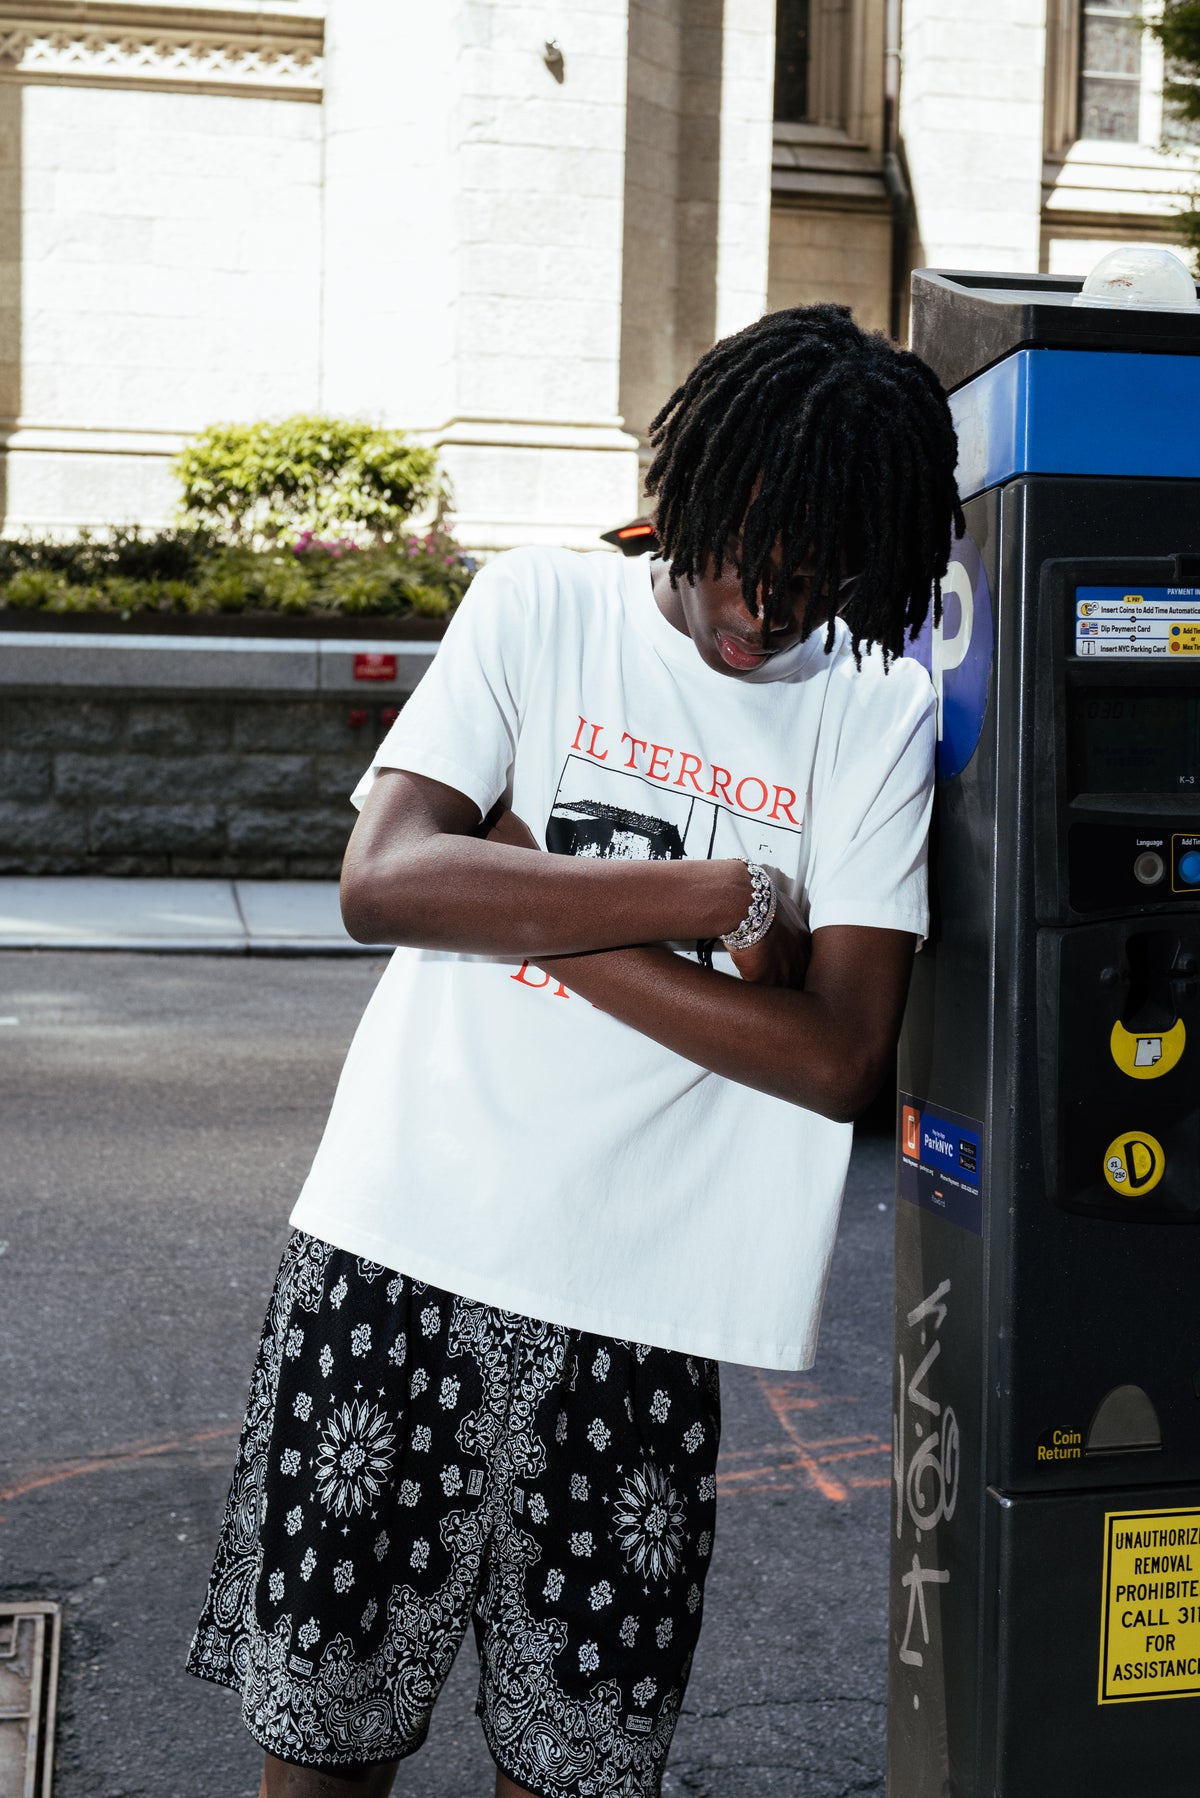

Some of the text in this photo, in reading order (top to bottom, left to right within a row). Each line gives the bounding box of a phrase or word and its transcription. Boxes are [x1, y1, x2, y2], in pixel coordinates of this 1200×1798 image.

[1167, 588, 1194, 596] PAYMENT
[1101, 606, 1118, 614] Insert
[1119, 606, 1135, 614] Coins
[1143, 606, 1155, 614] Add
[1101, 625, 1111, 634] Dip
[1112, 625, 1136, 633] Payment
[1137, 625, 1151, 633] Card
[932, 560, 974, 741] P
[1118, 645, 1130, 653] NYC
[1131, 645, 1152, 654] Parking
[1153, 645, 1166, 653] Card
[570, 715, 803, 826] IL TERROR
[1179, 775, 1195, 784] K-3
[1136, 838, 1163, 847] Language
[1181, 838, 1192, 846] Add
[924, 1133, 954, 1157] ParkNYC
[1053, 1430, 1081, 1445] Coin
[1037, 1445, 1081, 1461] Return
[1115, 1527, 1200, 1550] UNAUTHORIZ
[1134, 1554, 1193, 1575] REMOVAL
[1121, 1608, 1169, 1629] CALL
[1146, 1633, 1175, 1652] FOR
